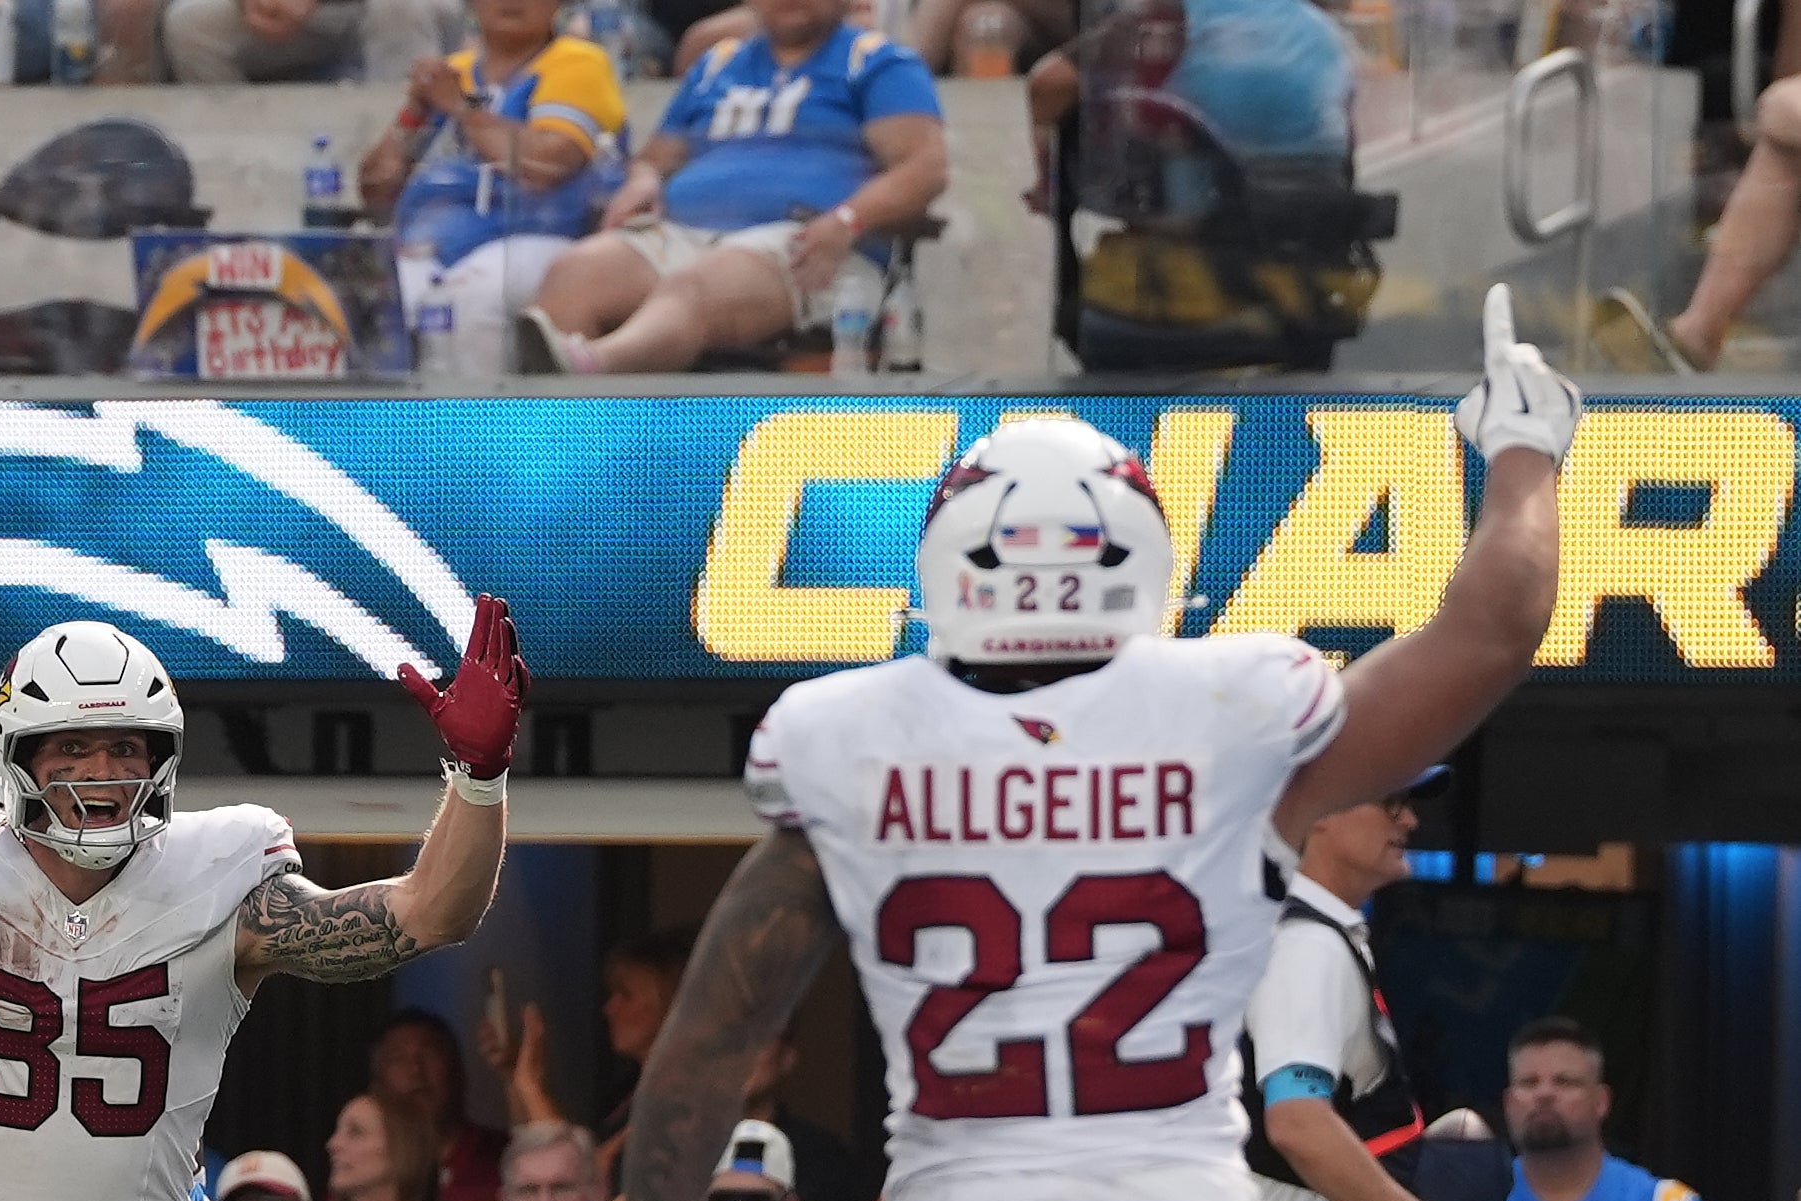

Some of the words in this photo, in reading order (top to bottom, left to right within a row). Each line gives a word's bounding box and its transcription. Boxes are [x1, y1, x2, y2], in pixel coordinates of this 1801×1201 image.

[1015, 575, 1080, 612] 22
[78, 700, 127, 710] CARDINALS
[877, 761, 1195, 842] ALLGEIER
[876, 868, 1213, 1121] 22
